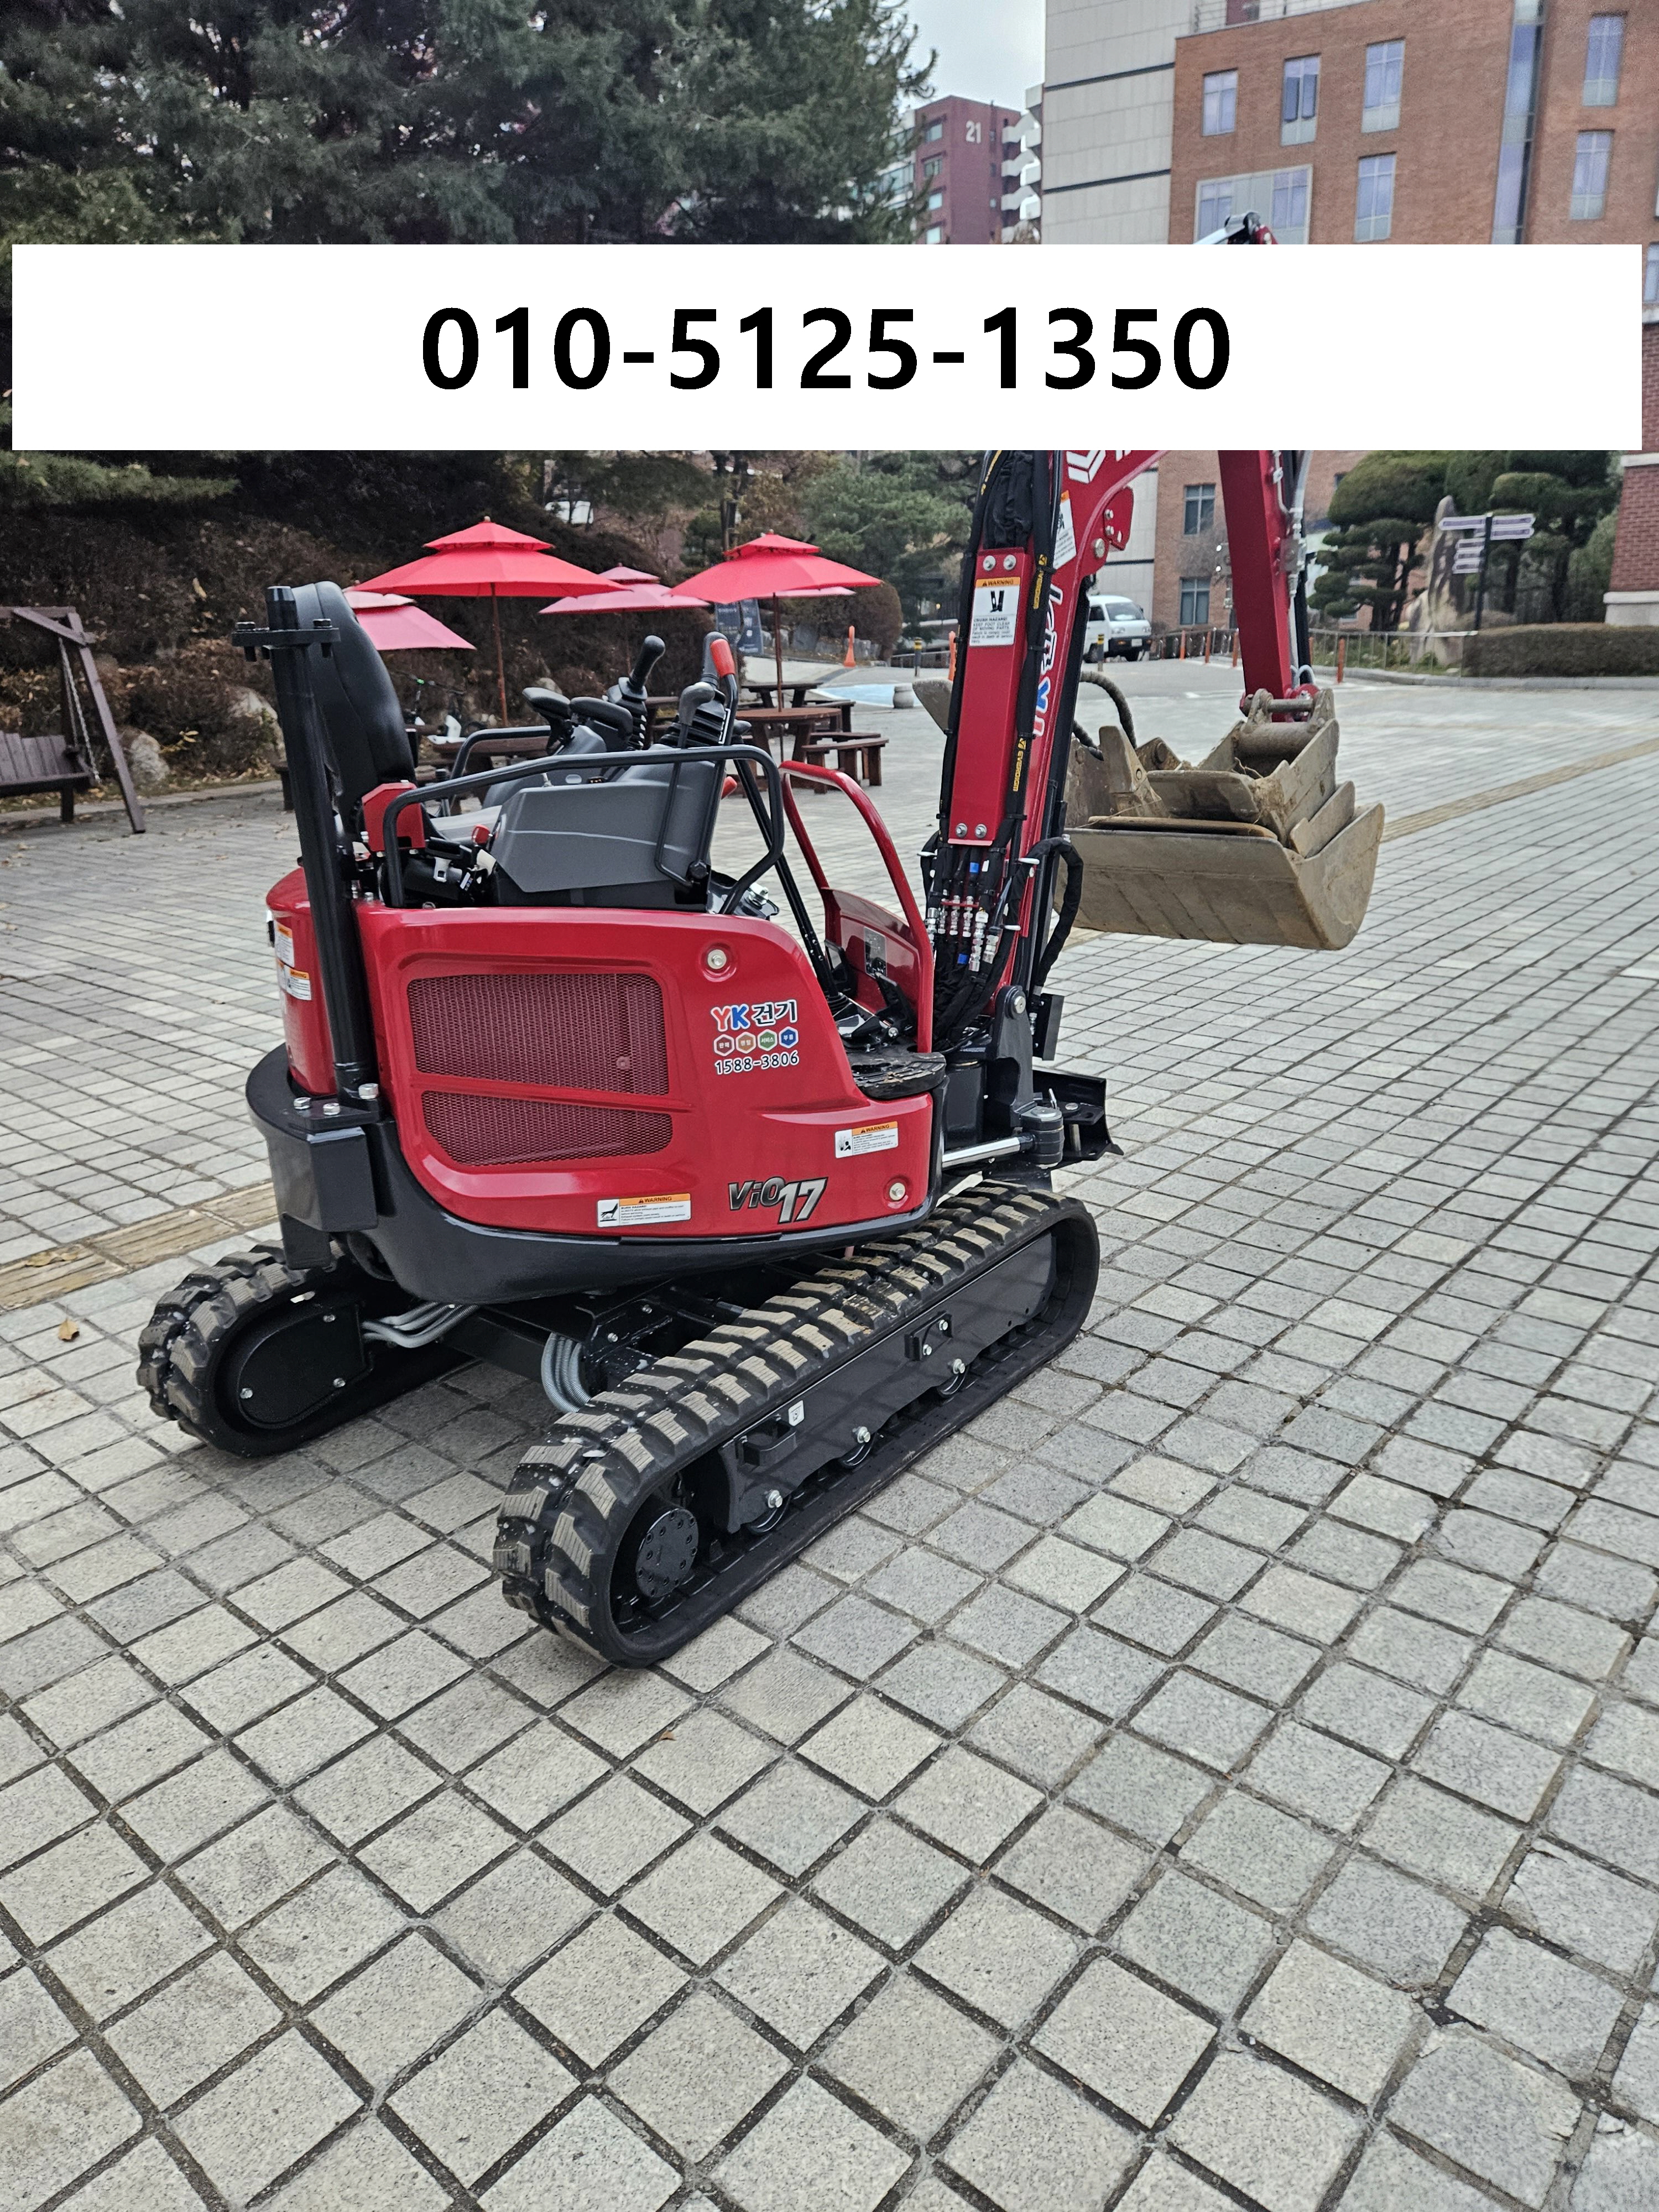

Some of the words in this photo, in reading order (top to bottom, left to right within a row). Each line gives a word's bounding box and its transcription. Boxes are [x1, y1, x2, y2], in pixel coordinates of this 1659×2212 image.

[966, 120, 981, 144] 21
[711, 1004, 750, 1031] YK
[752, 1000, 797, 1026] 건기
[716, 1051, 798, 1074] 1588-3806
[865, 1124, 890, 1133] WARNING
